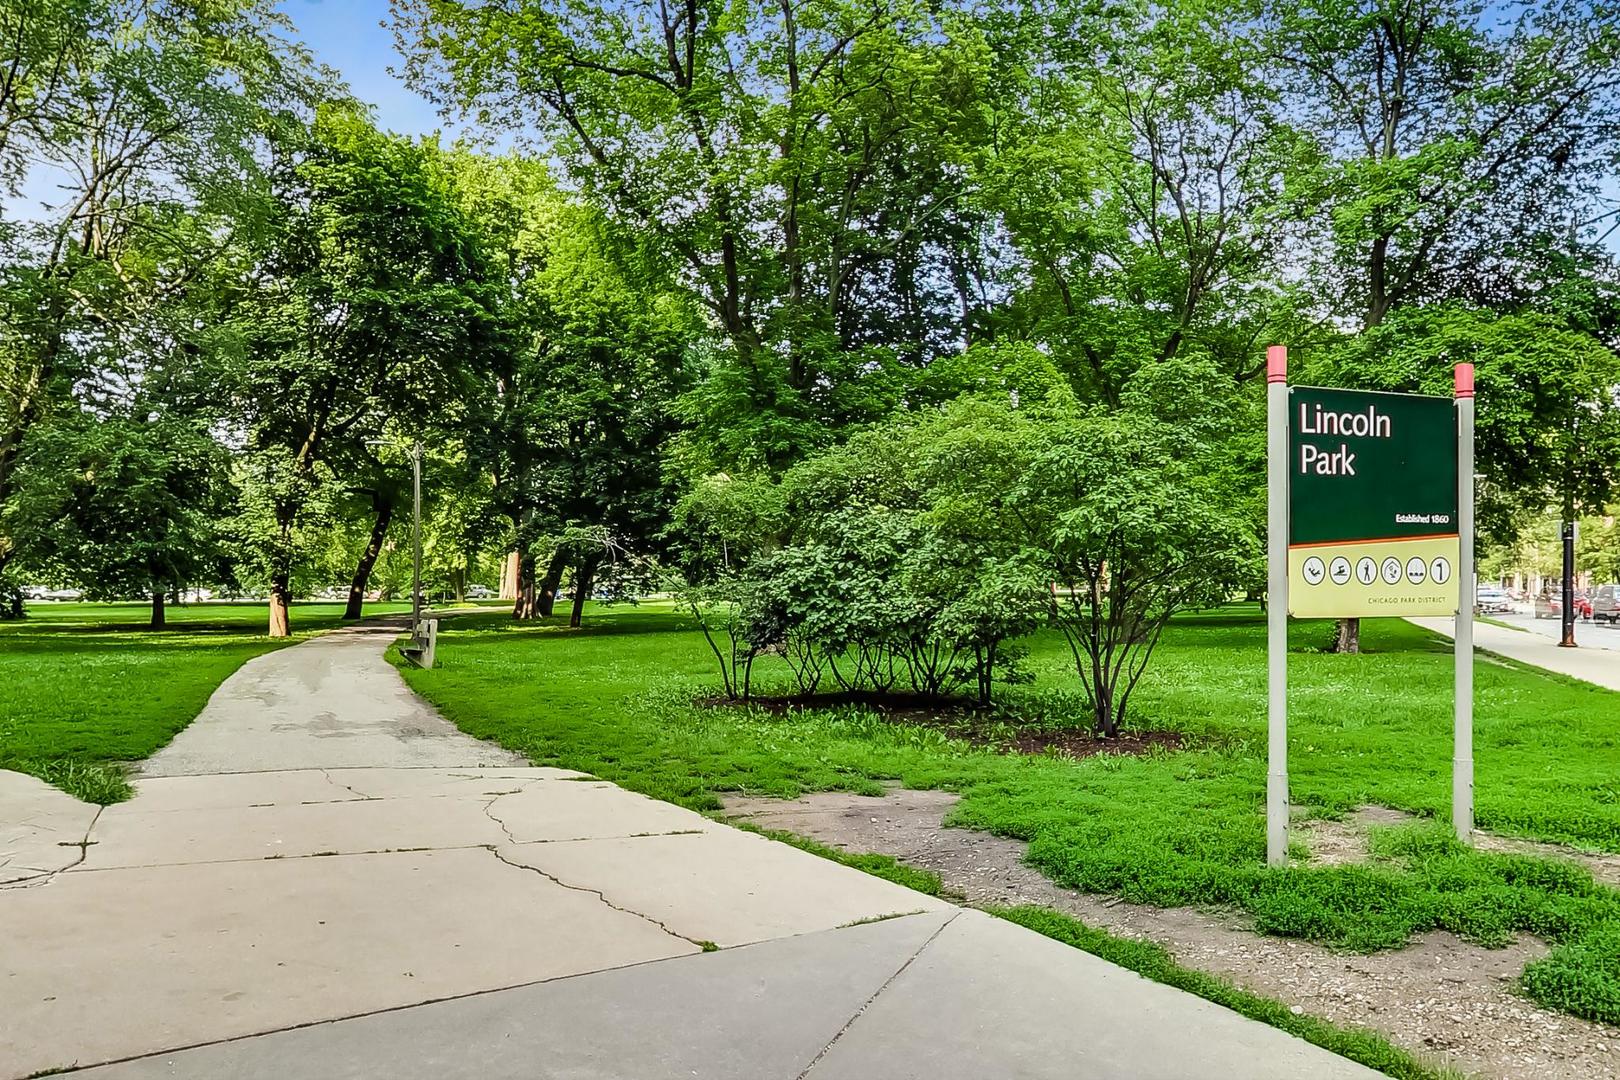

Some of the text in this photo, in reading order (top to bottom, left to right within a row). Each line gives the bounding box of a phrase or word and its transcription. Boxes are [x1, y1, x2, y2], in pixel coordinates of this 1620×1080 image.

[1300, 402, 1391, 438] Lincoln
[1301, 444, 1356, 476] Park
[1395, 514, 1449, 524] Established 1860
[1368, 597, 1398, 605] CHICAGO
[1418, 596, 1446, 604] DISTRICT
